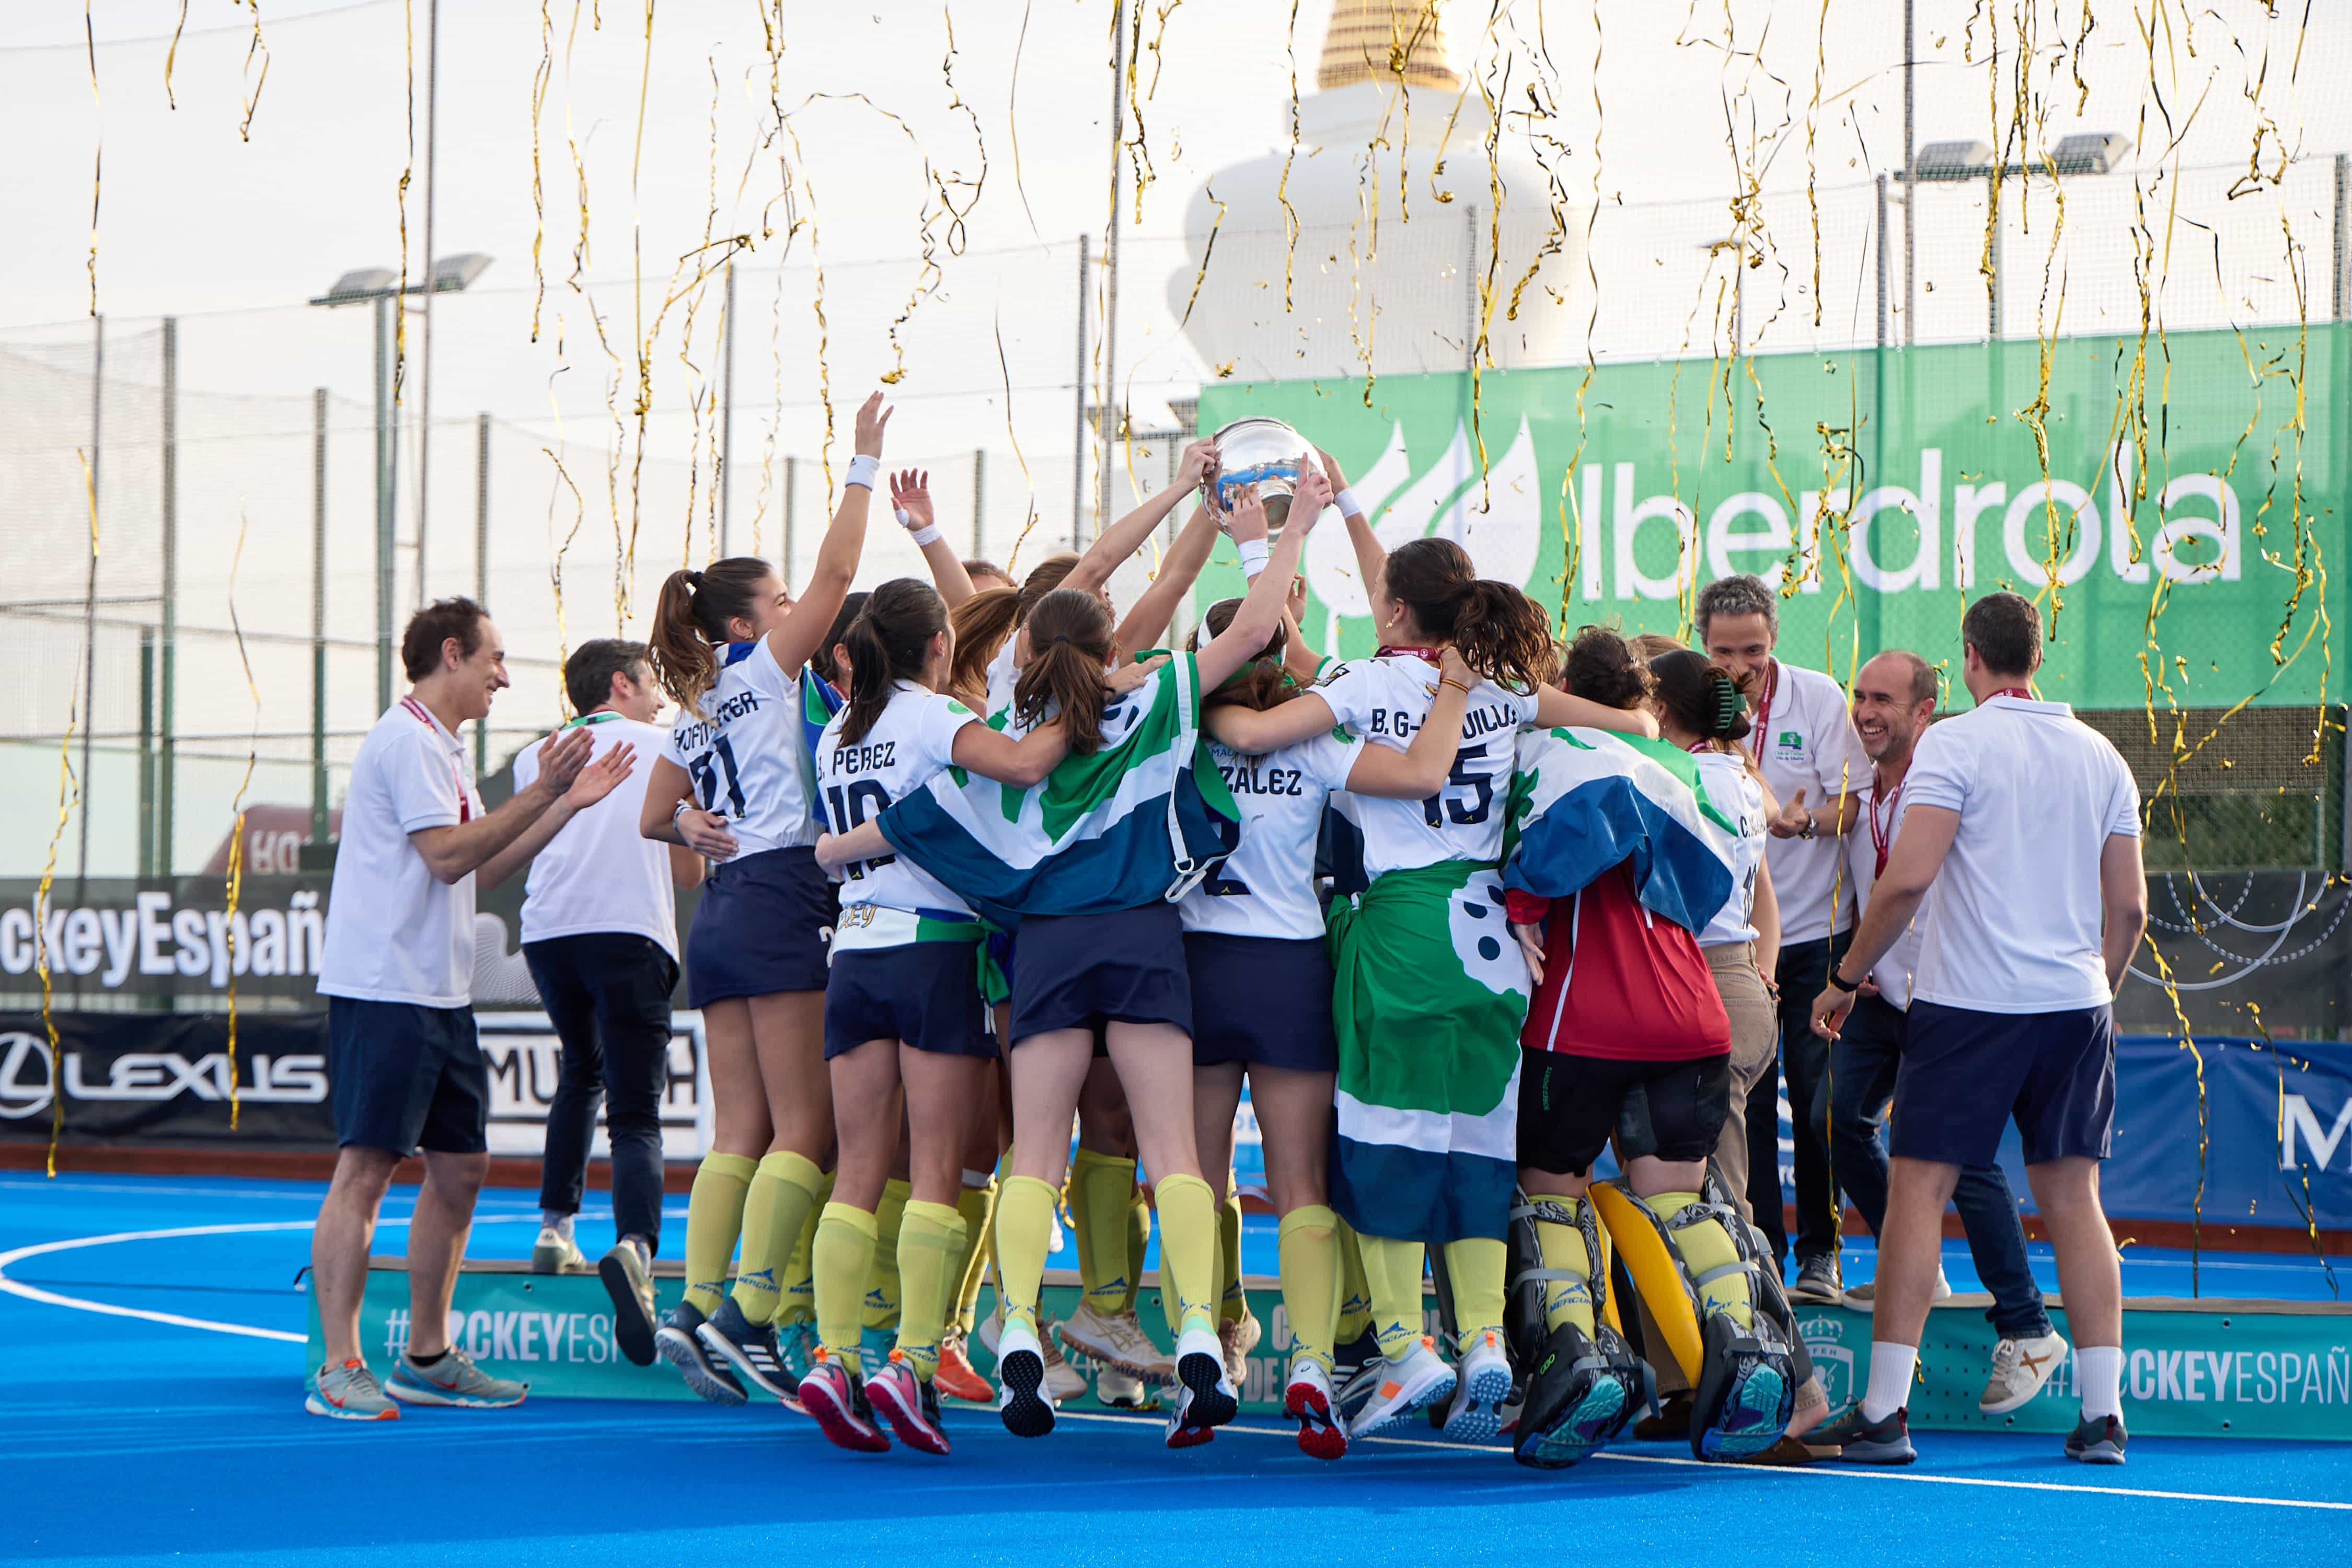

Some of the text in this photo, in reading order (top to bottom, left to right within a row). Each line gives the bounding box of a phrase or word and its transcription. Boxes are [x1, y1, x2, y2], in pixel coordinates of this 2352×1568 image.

[1581, 441, 2241, 601] Iberdrola
[833, 741, 895, 776] PEREZ
[1218, 766, 1302, 796] ZALEZ
[827, 779, 895, 881] 10
[0, 891, 327, 988] ckeyEspañ
[63, 1052, 329, 1103] LEXUS
[480, 1047, 702, 1105] MUH
